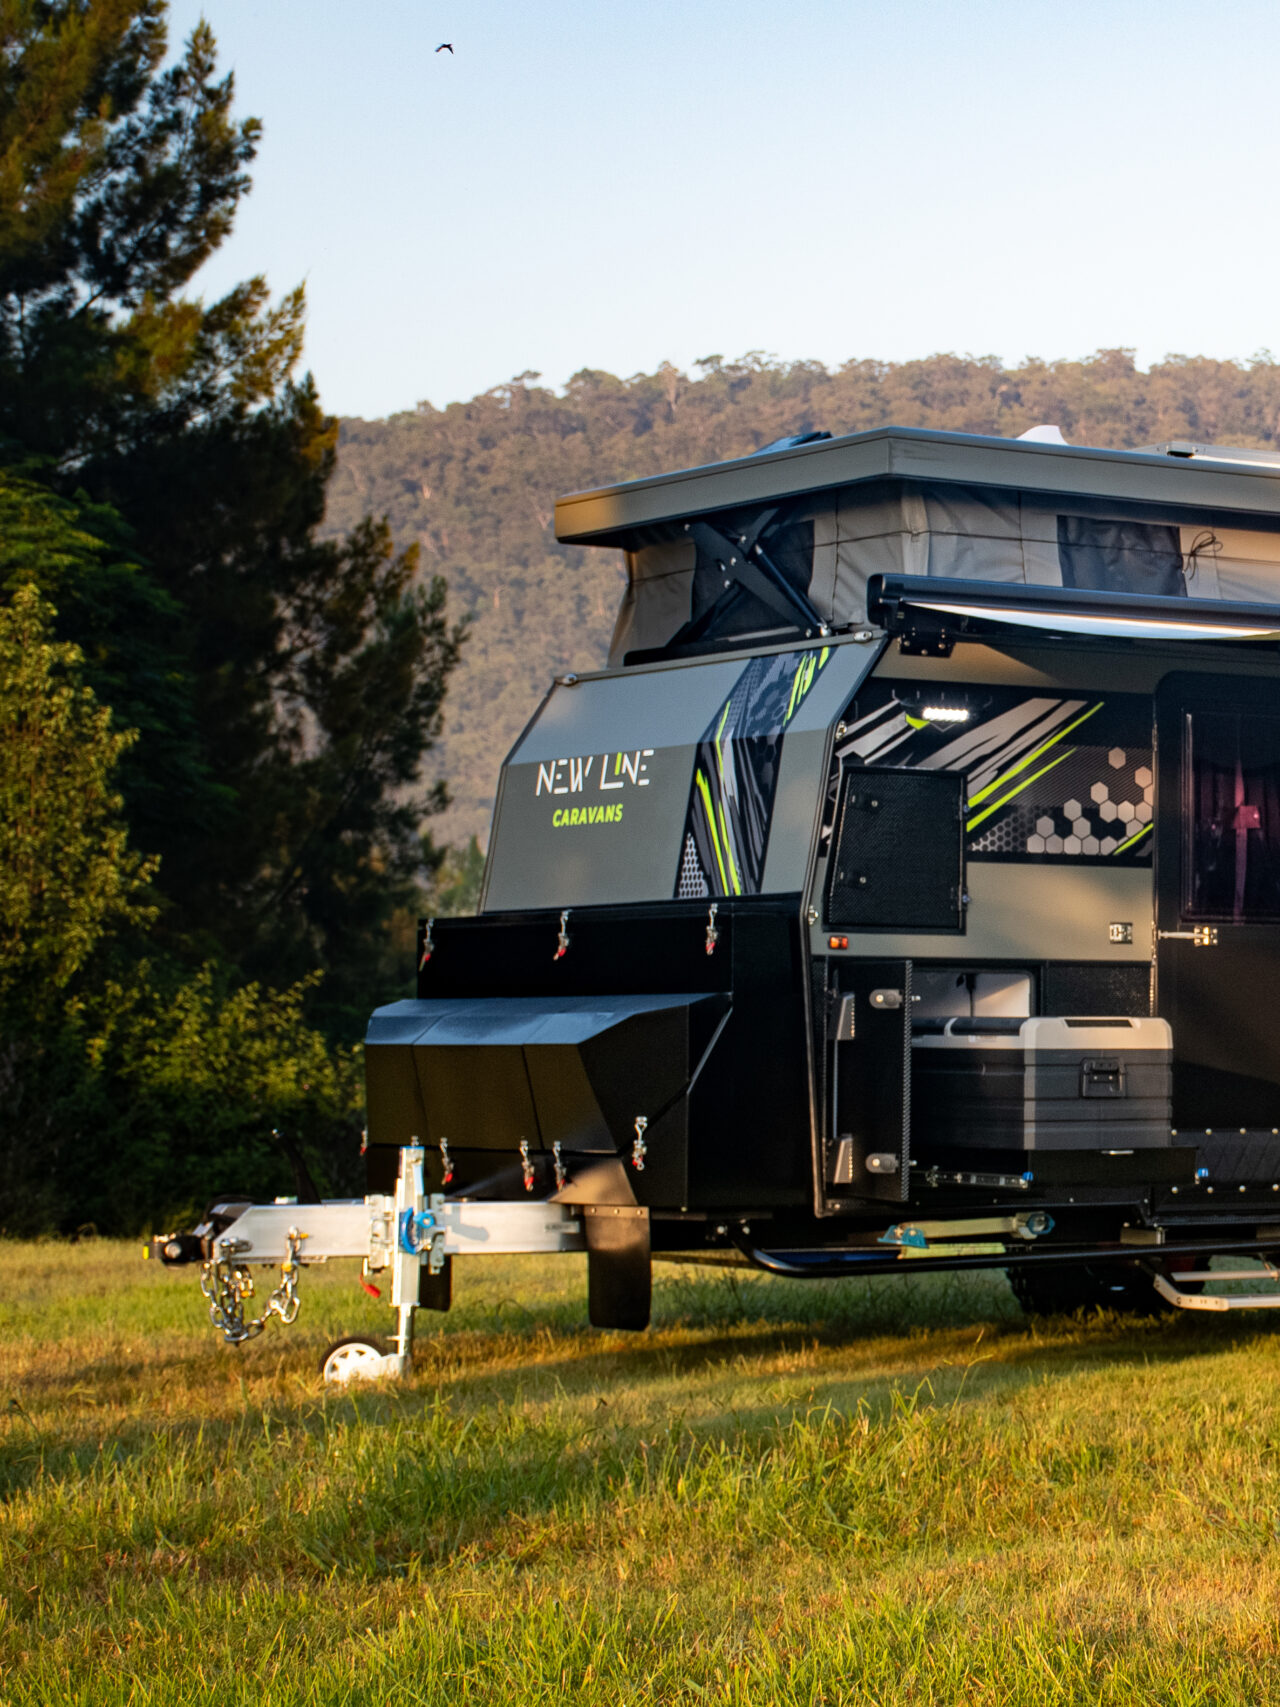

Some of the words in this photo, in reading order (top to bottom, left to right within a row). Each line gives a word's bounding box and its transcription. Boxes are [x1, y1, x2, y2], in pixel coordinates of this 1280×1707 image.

[536, 756, 594, 796] NEW
[600, 750, 655, 790] LINE
[552, 804, 624, 828] CARAVANS
